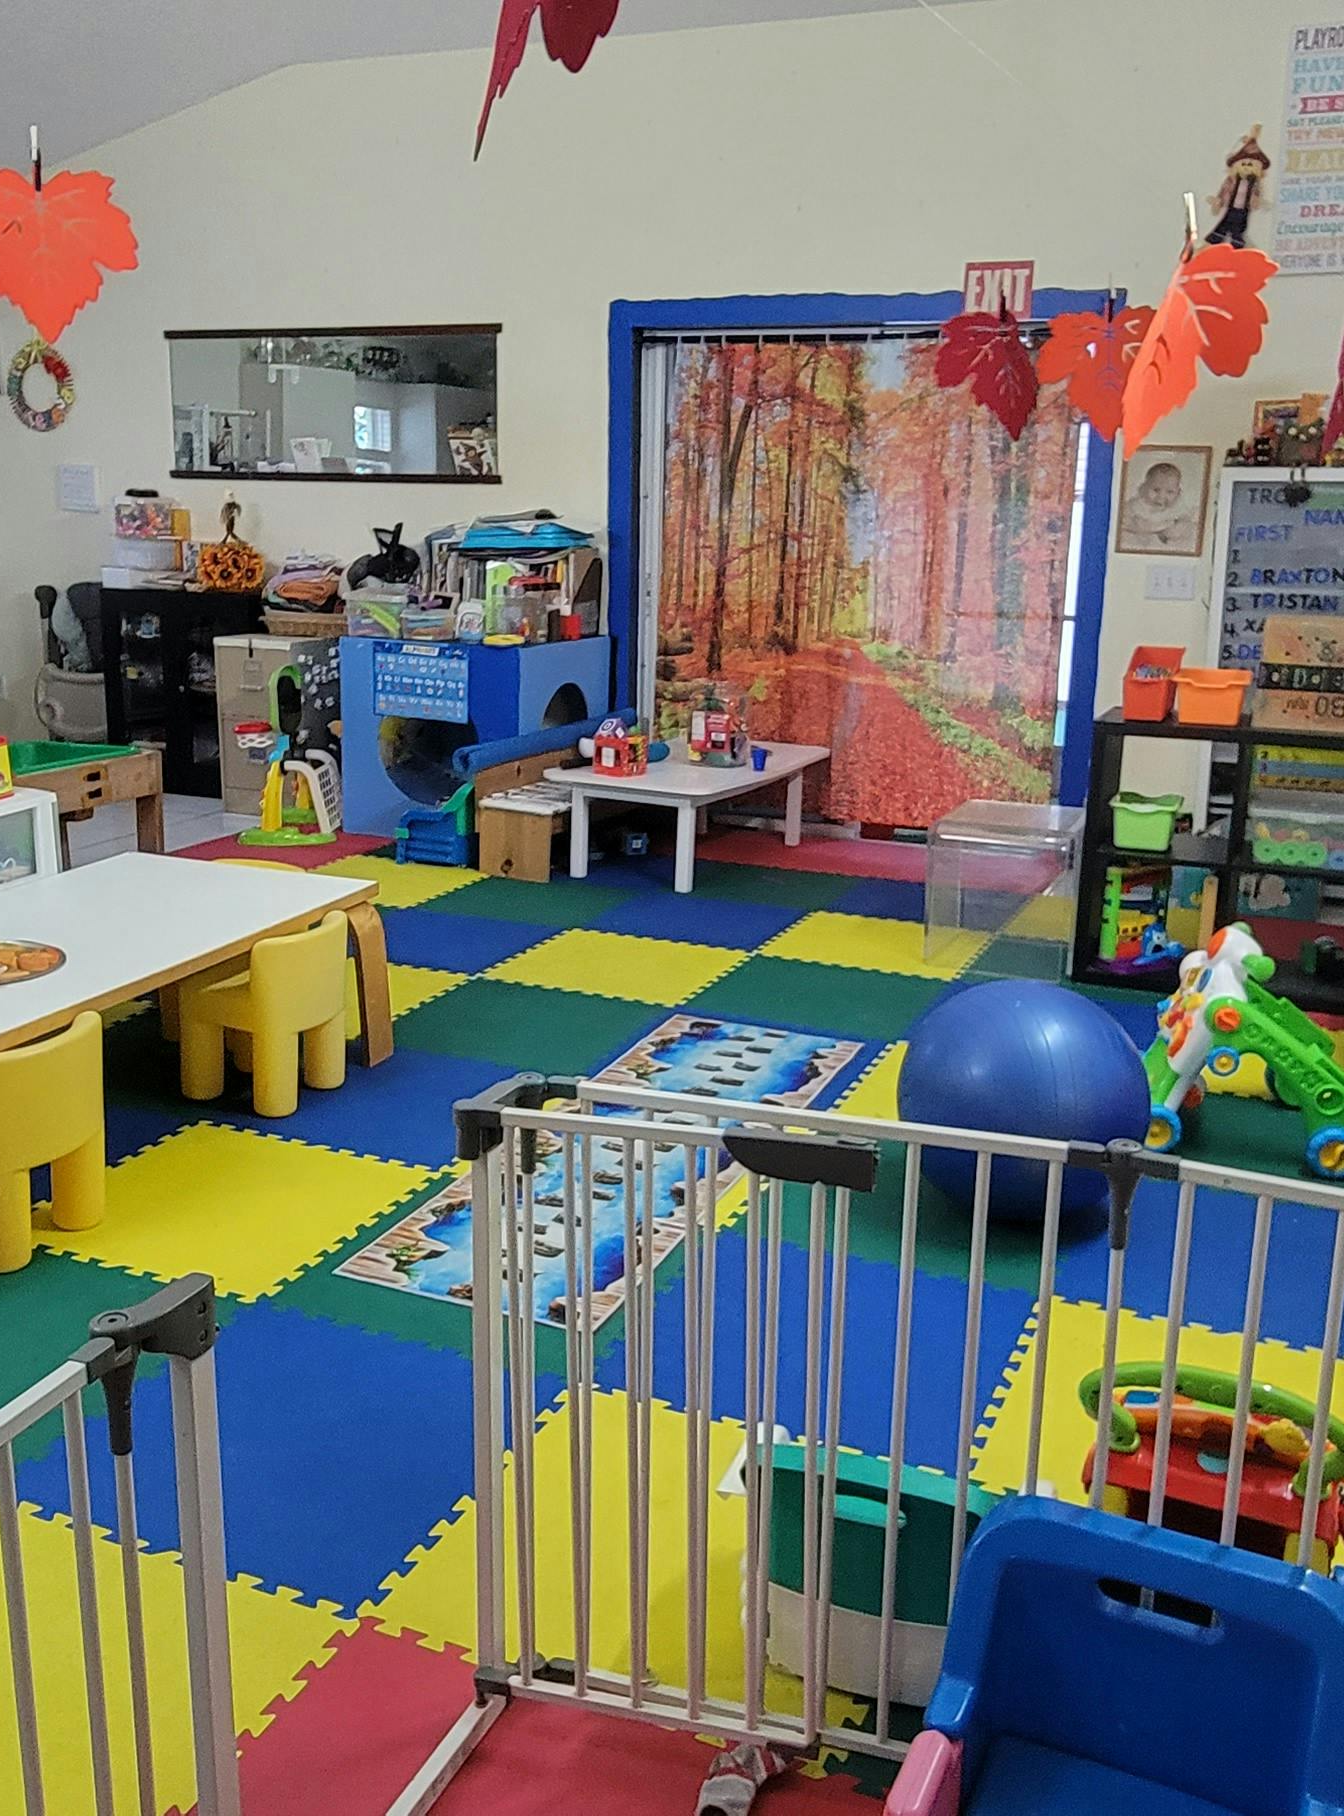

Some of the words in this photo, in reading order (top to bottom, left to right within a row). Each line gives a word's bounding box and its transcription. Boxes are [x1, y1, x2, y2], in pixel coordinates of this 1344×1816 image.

[1292, 75, 1344, 94] FUN
[1305, 97, 1330, 112] BE
[1277, 220, 1344, 236] Encourage
[964, 267, 1031, 313] EXIT
[1235, 524, 1293, 543] FIRST
[1251, 594, 1340, 611] TRISTAN
